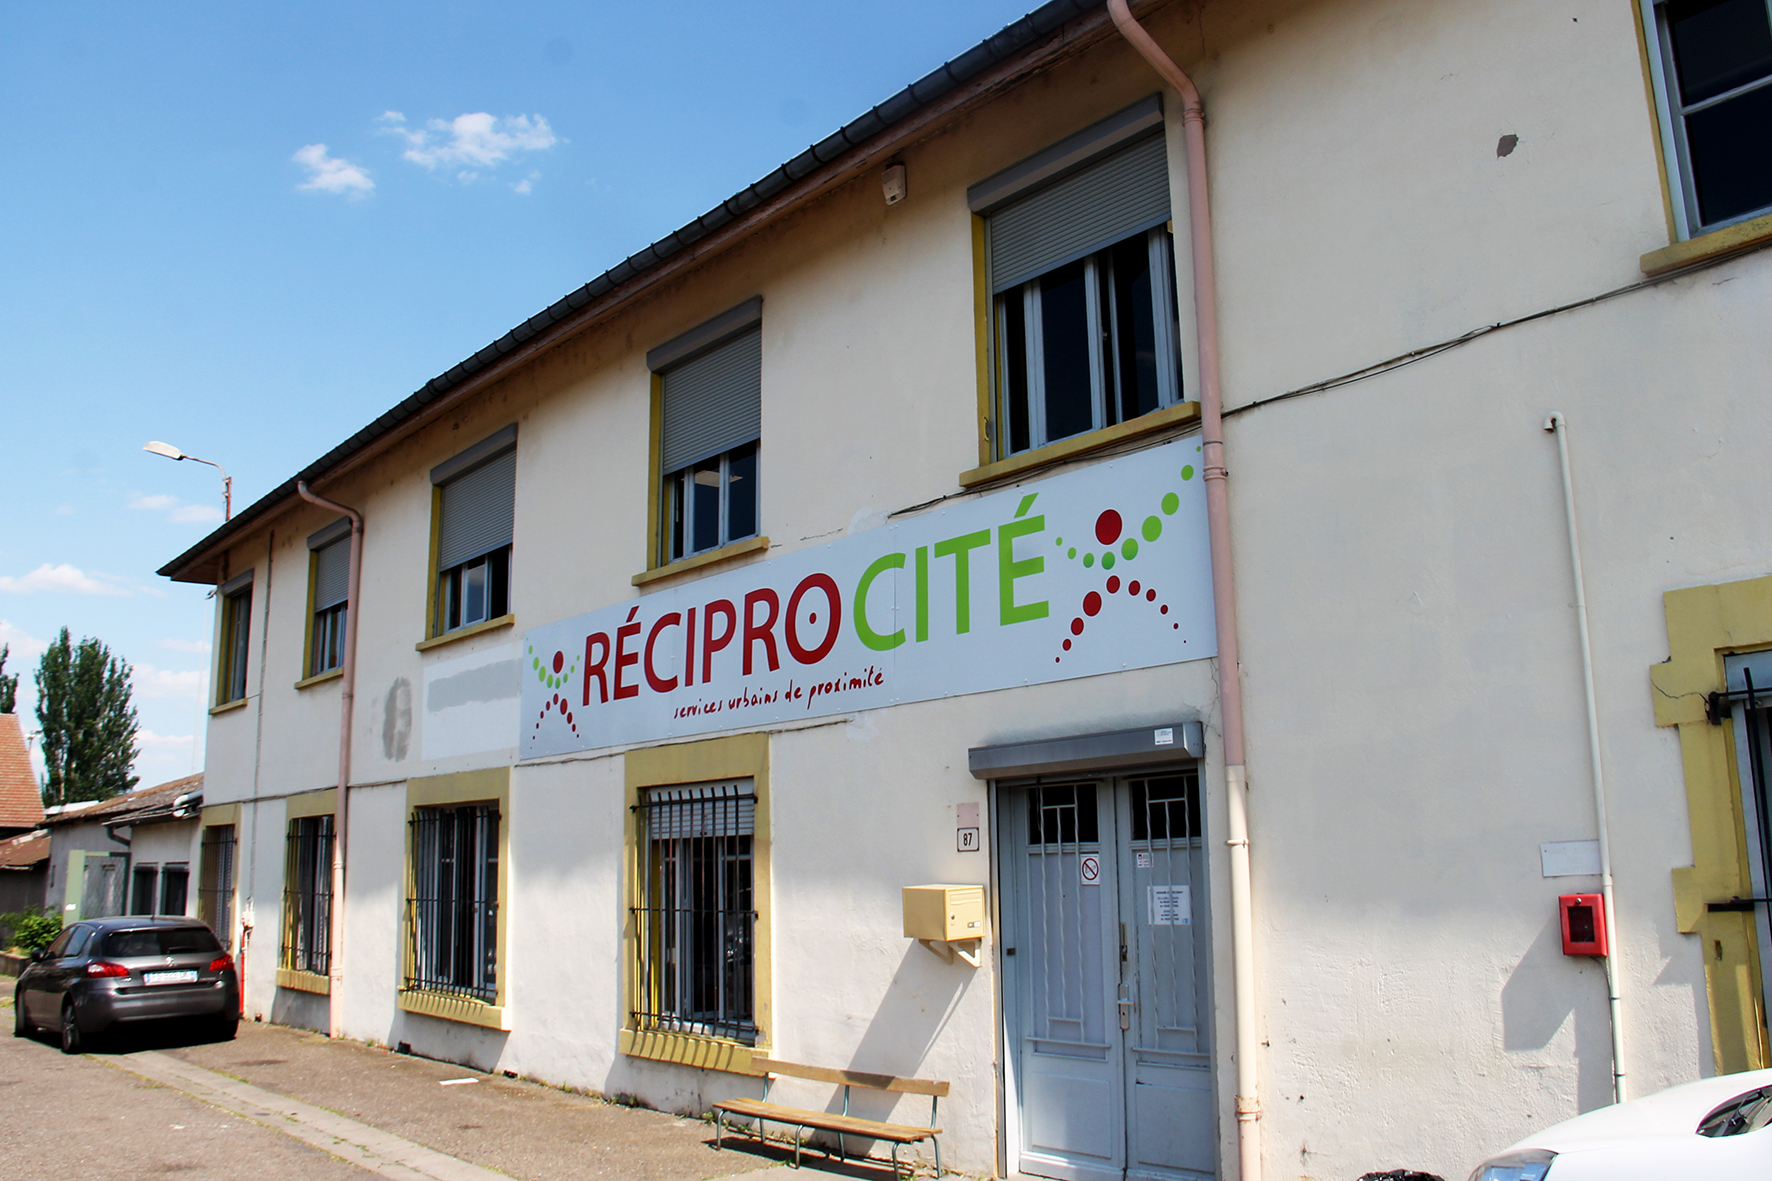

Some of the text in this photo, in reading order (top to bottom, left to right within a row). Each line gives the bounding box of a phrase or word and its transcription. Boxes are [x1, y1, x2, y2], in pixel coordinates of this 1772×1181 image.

[674, 665, 884, 719] services urbains de proximité
[963, 832, 973, 846] 87
